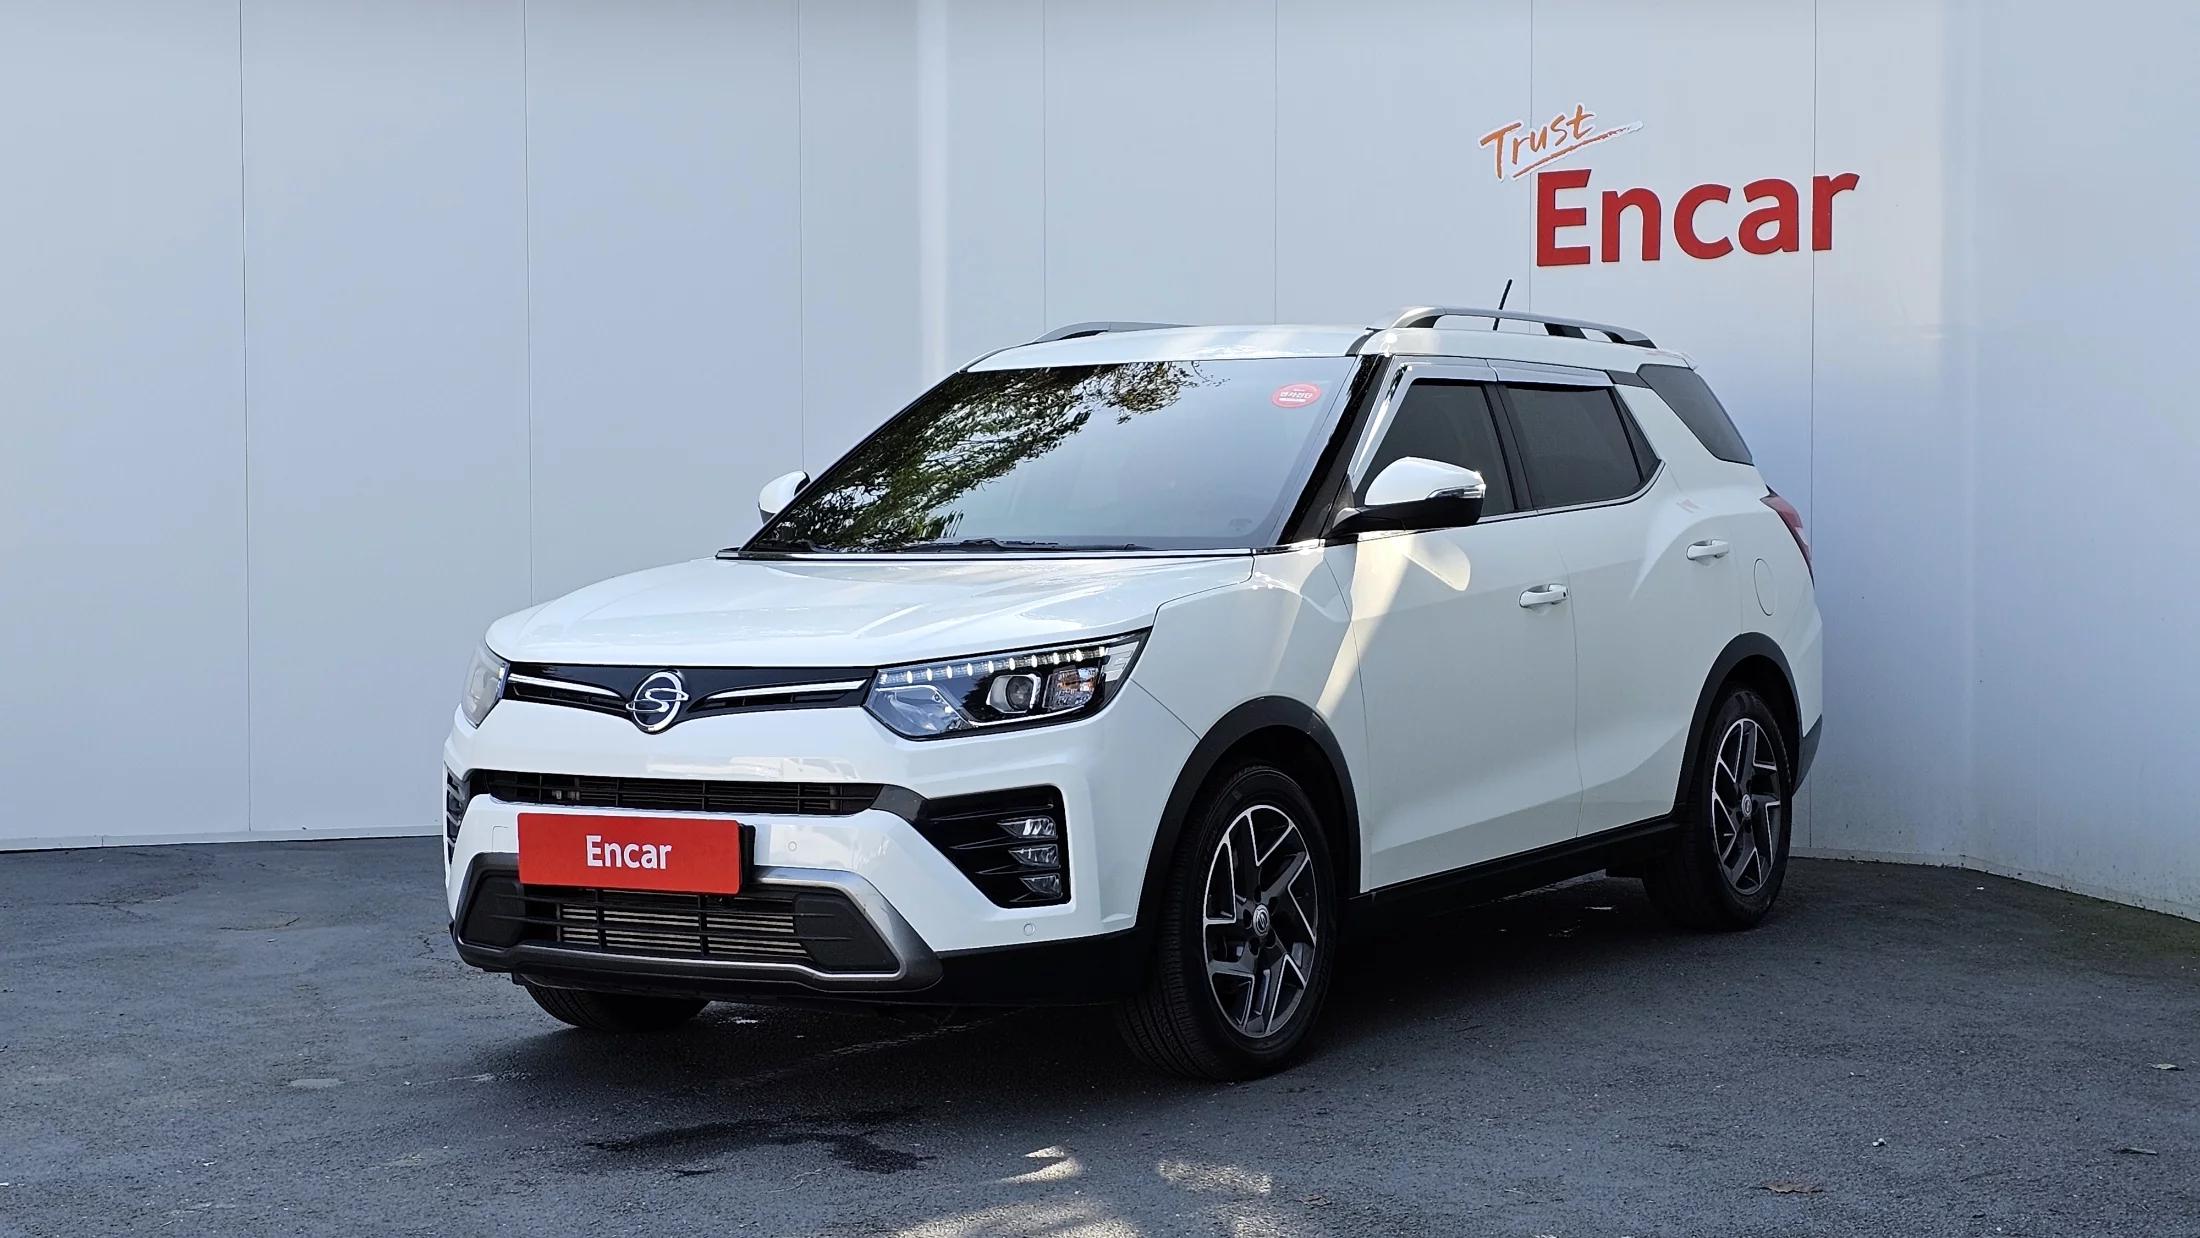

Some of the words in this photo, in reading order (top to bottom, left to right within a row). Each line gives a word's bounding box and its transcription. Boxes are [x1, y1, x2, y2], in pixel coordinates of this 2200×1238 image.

[1480, 104, 1595, 179] Trust
[1537, 170, 1860, 266] Encar
[585, 834, 673, 869] Encar
